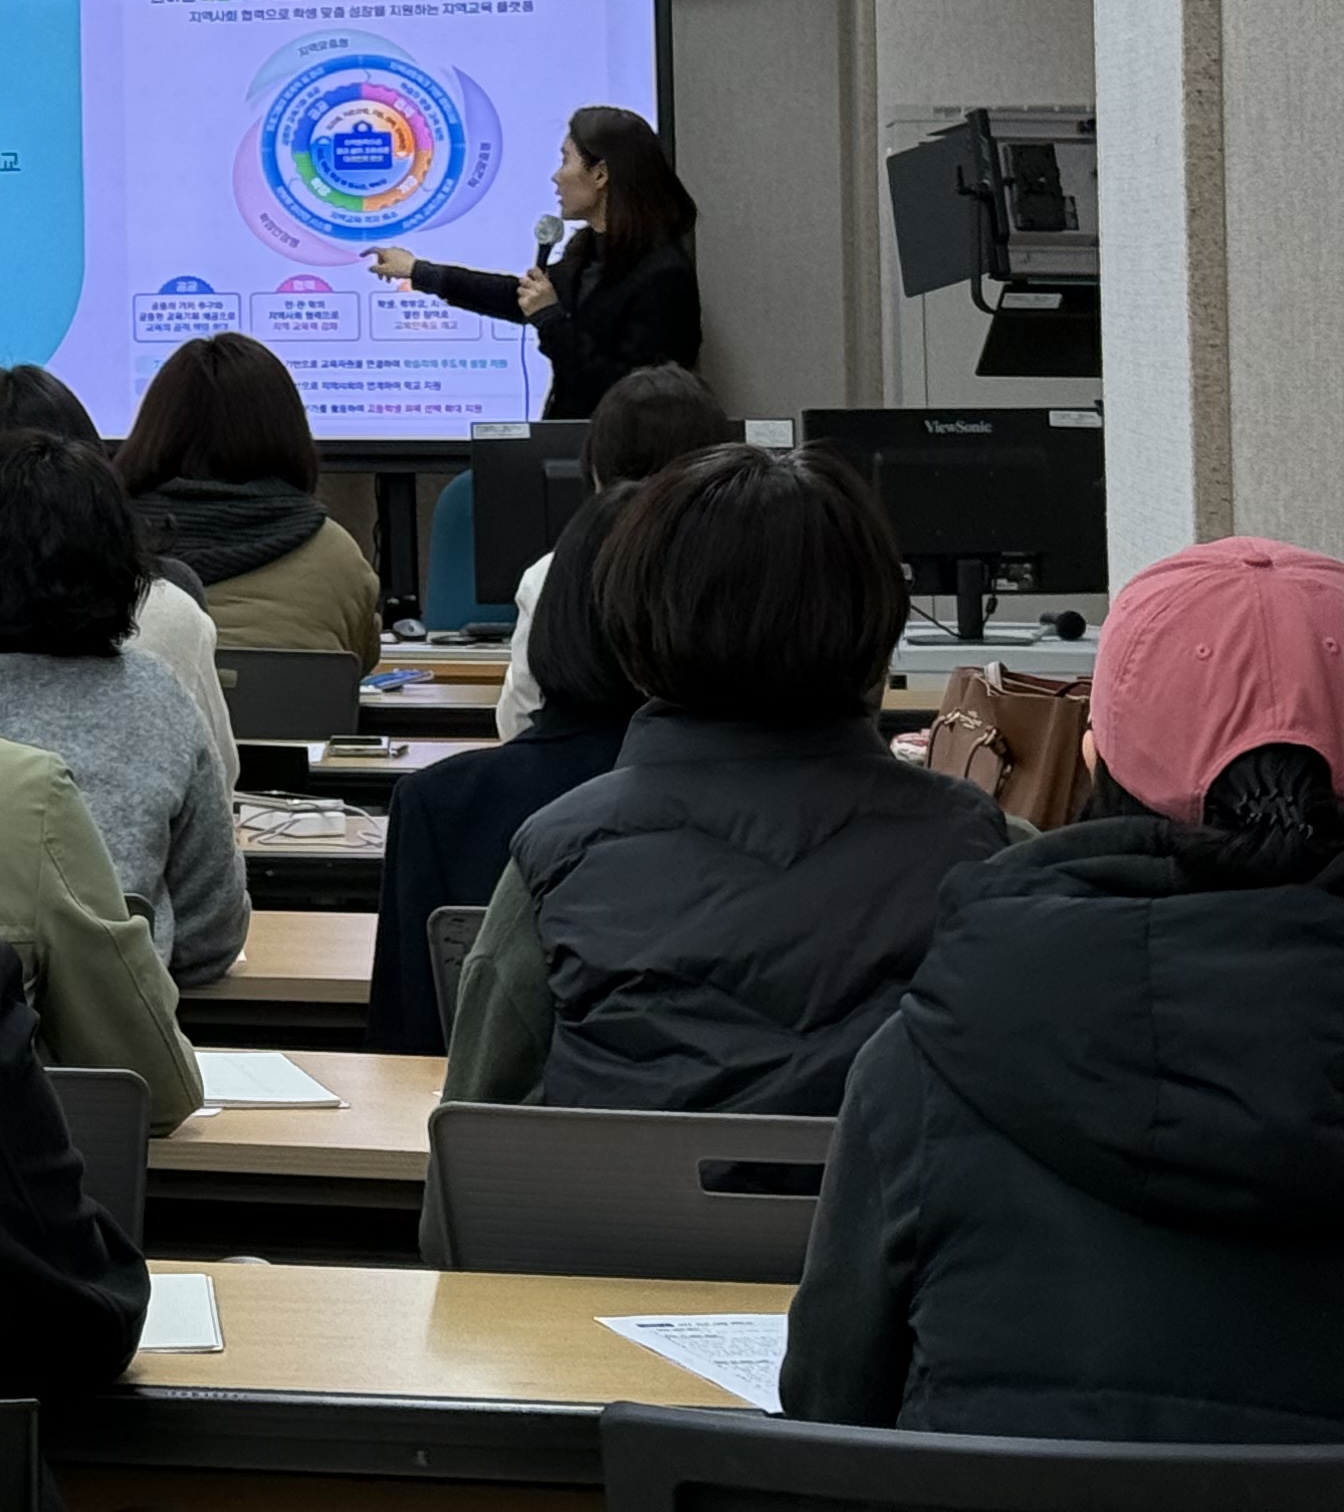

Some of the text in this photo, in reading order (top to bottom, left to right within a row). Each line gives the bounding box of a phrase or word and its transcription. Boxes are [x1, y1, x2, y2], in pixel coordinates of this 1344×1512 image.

[188, 9, 237, 23] 지역사회
[389, 3, 439, 16] 지원하는
[924, 419, 993, 434] ViewSonic
